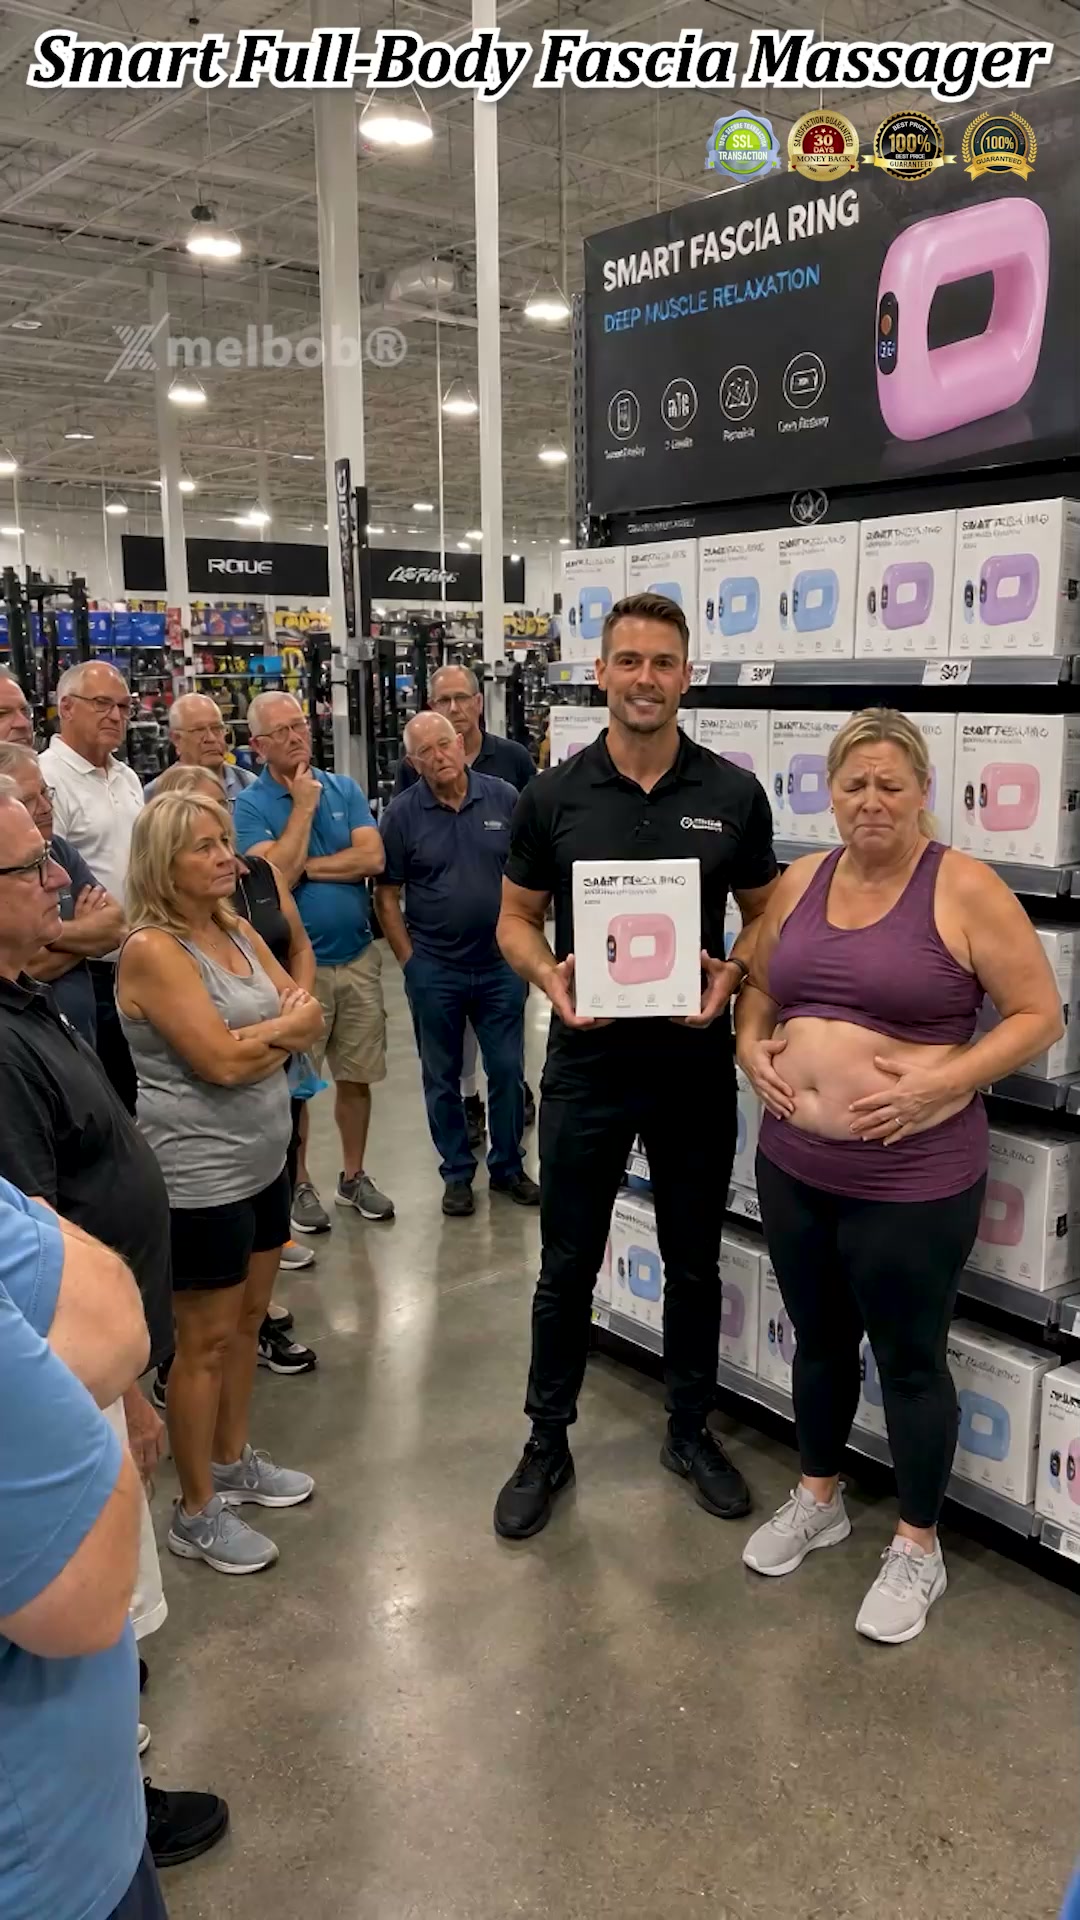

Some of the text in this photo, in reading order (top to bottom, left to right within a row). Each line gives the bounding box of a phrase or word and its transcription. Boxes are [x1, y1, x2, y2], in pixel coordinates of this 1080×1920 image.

[603, 188, 860, 291] SMART FASCIA RING
[604, 307, 642, 333] DEEP
[713, 263, 821, 309] RELAXATION
